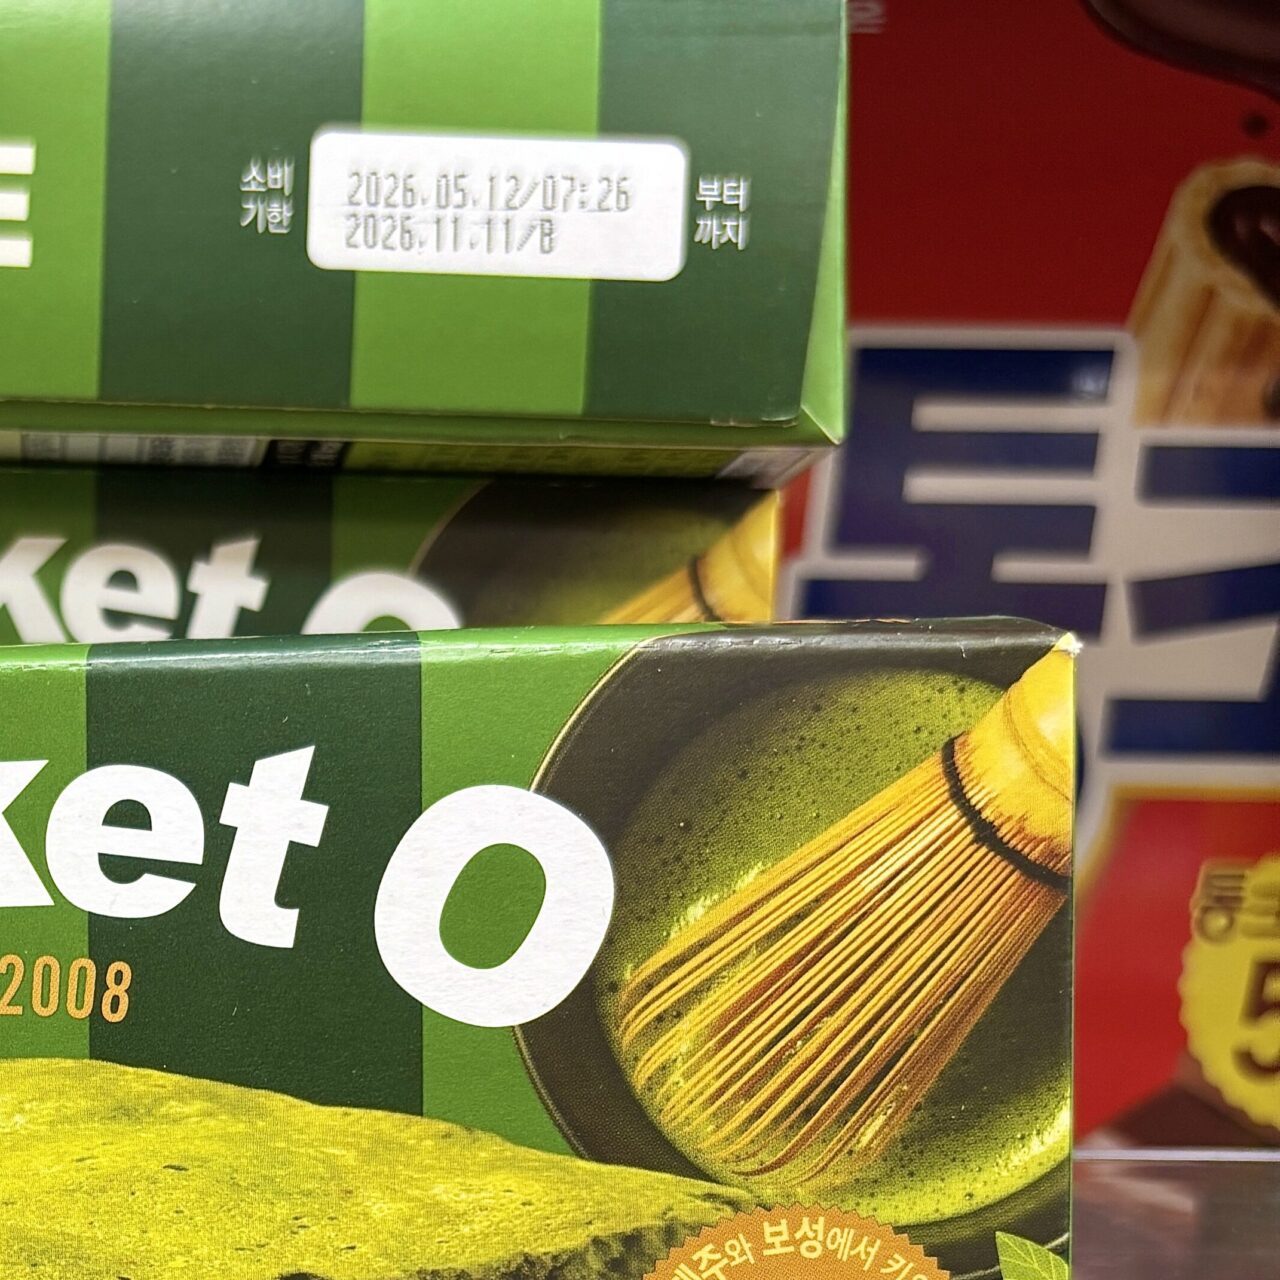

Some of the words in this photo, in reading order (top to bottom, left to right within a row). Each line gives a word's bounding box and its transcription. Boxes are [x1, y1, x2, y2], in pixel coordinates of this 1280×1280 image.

[240, 158, 295, 194] 소비
[695, 175, 751, 212] 부터
[240, 197, 294, 234] 기한
[694, 214, 751, 251] 까지
[374, 784, 615, 1028] O
[762, 1216, 882, 1272] 보성에서
